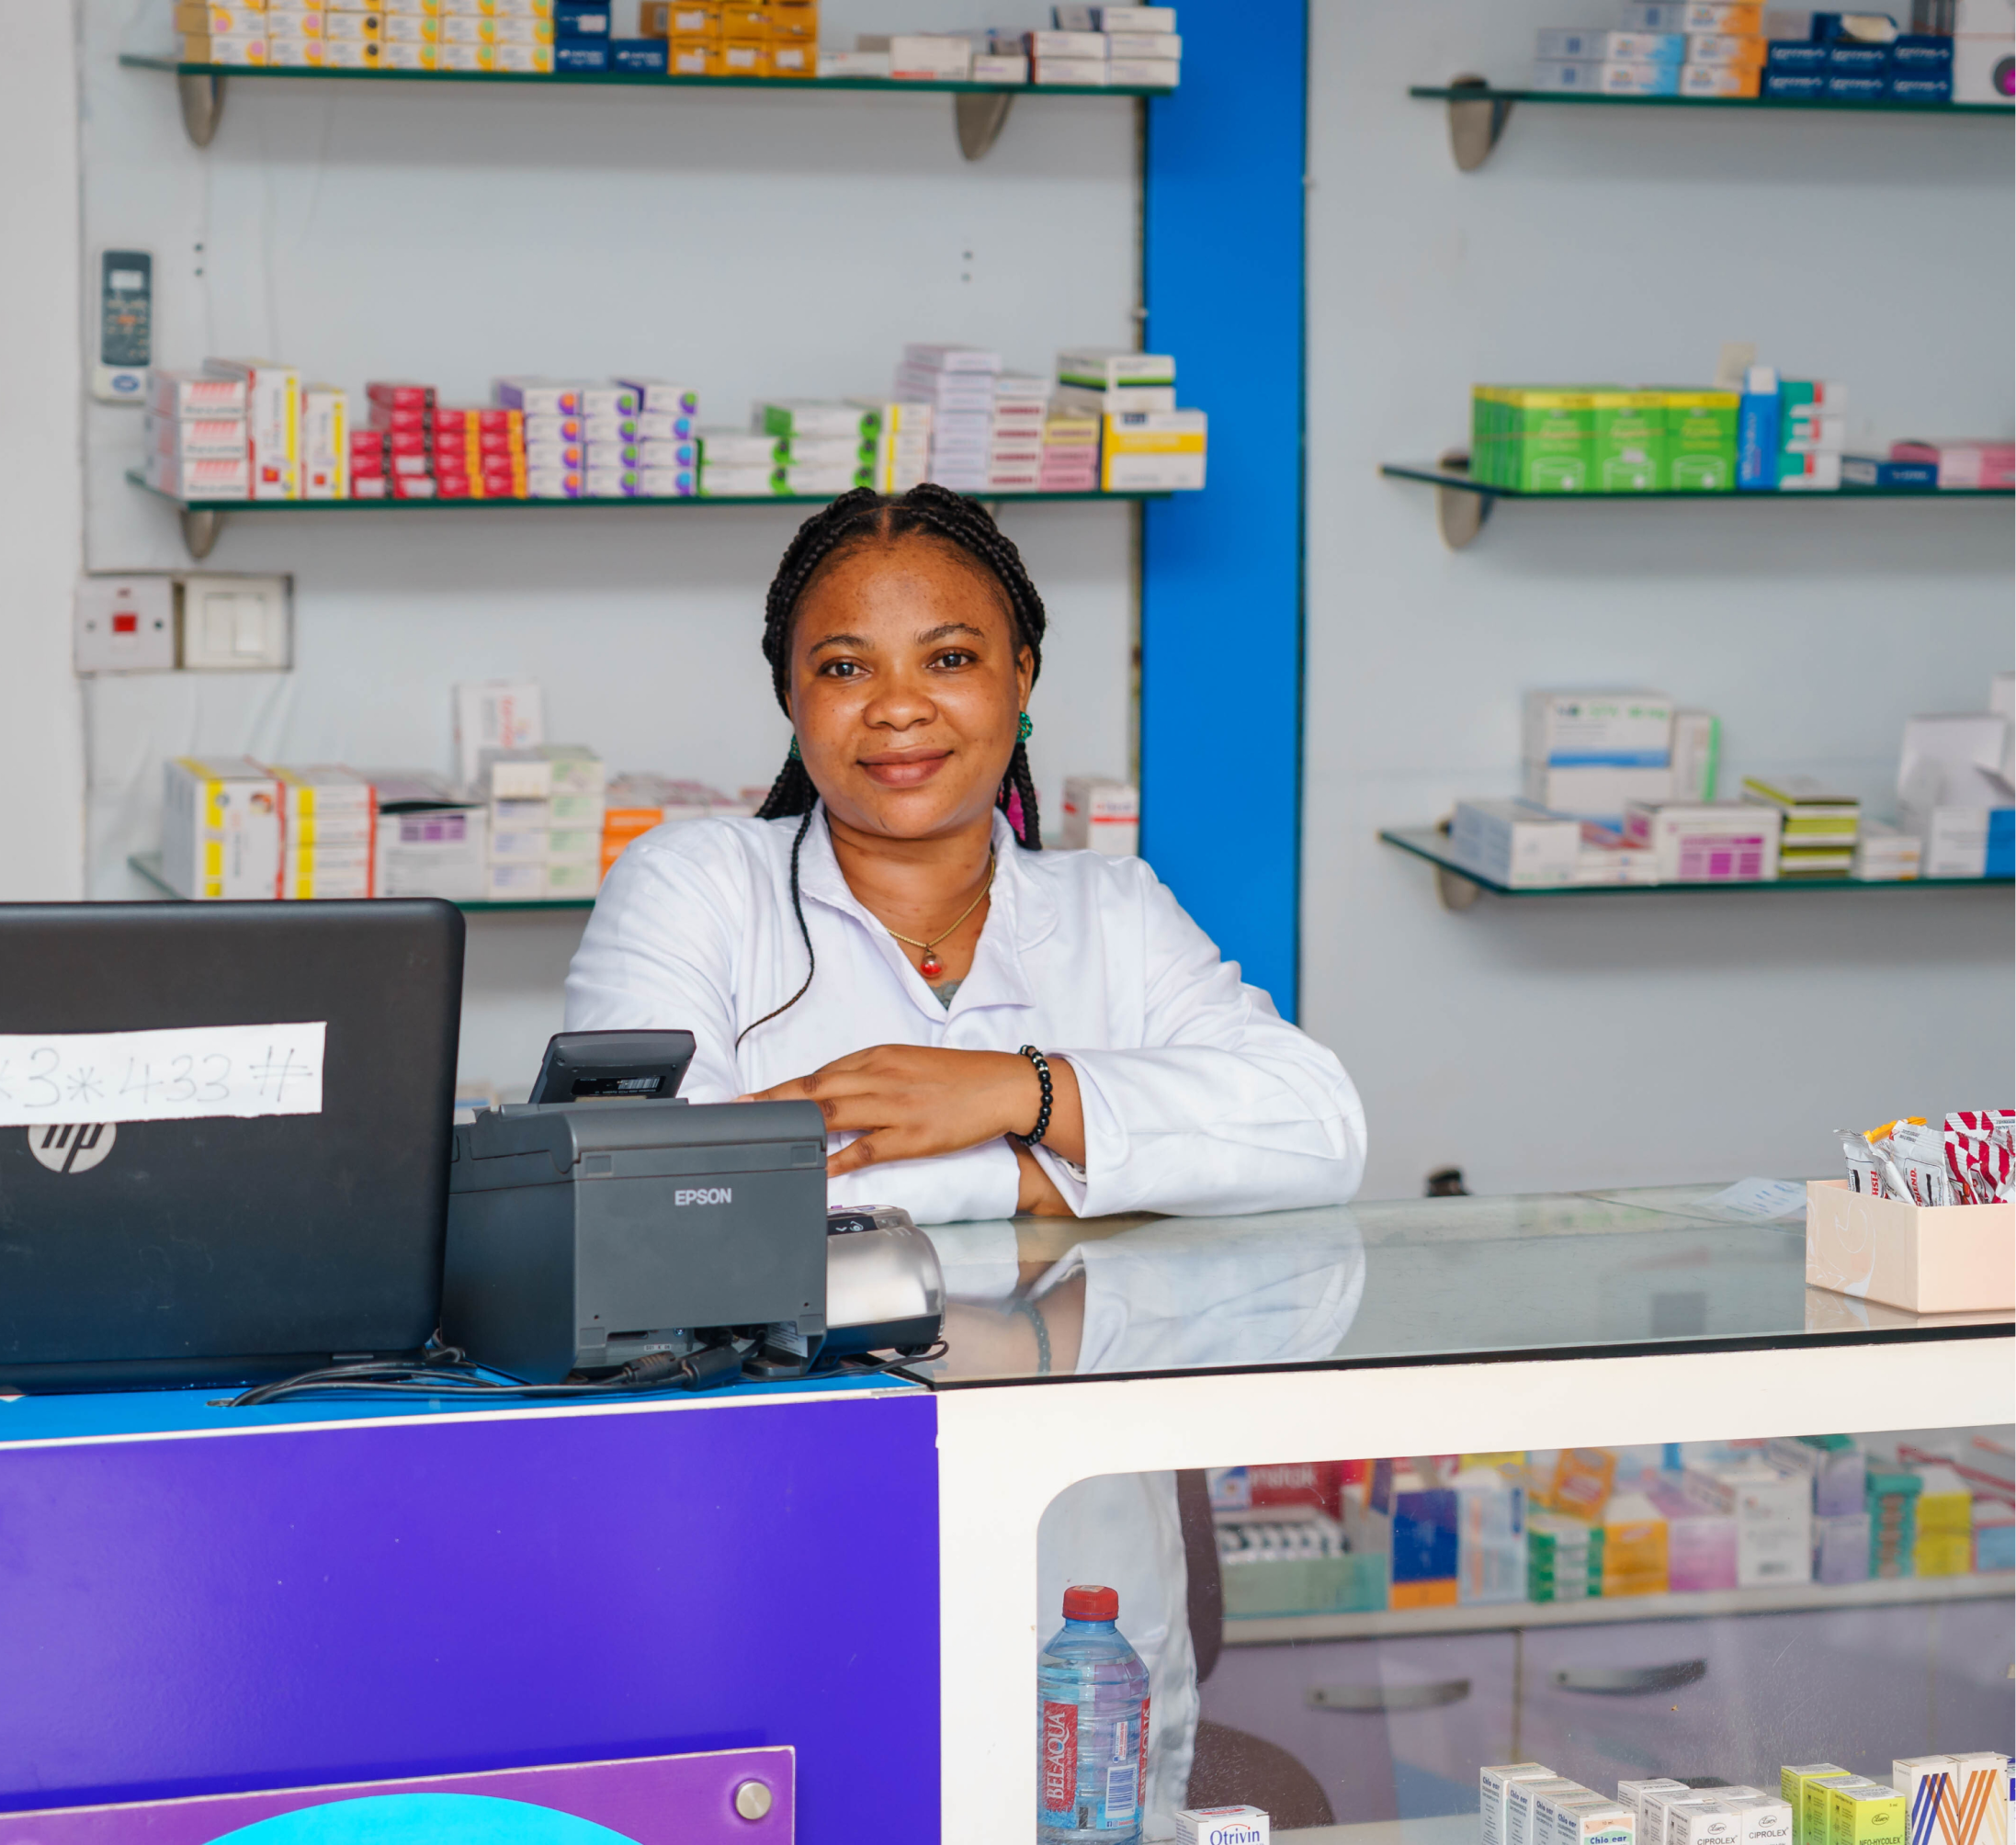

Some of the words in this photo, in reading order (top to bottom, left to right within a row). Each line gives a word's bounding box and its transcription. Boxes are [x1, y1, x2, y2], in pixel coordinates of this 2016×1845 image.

[1870, 1171, 1879, 1196] FISH
[1910, 1170, 1922, 1206] FRIEND
[674, 1188, 733, 1206] EPSON
[1210, 1827, 1260, 1845] Otrivin
[1697, 1837, 1736, 1845] CIPROLEX
[1749, 1828, 1787, 1839] CIPROLEX
